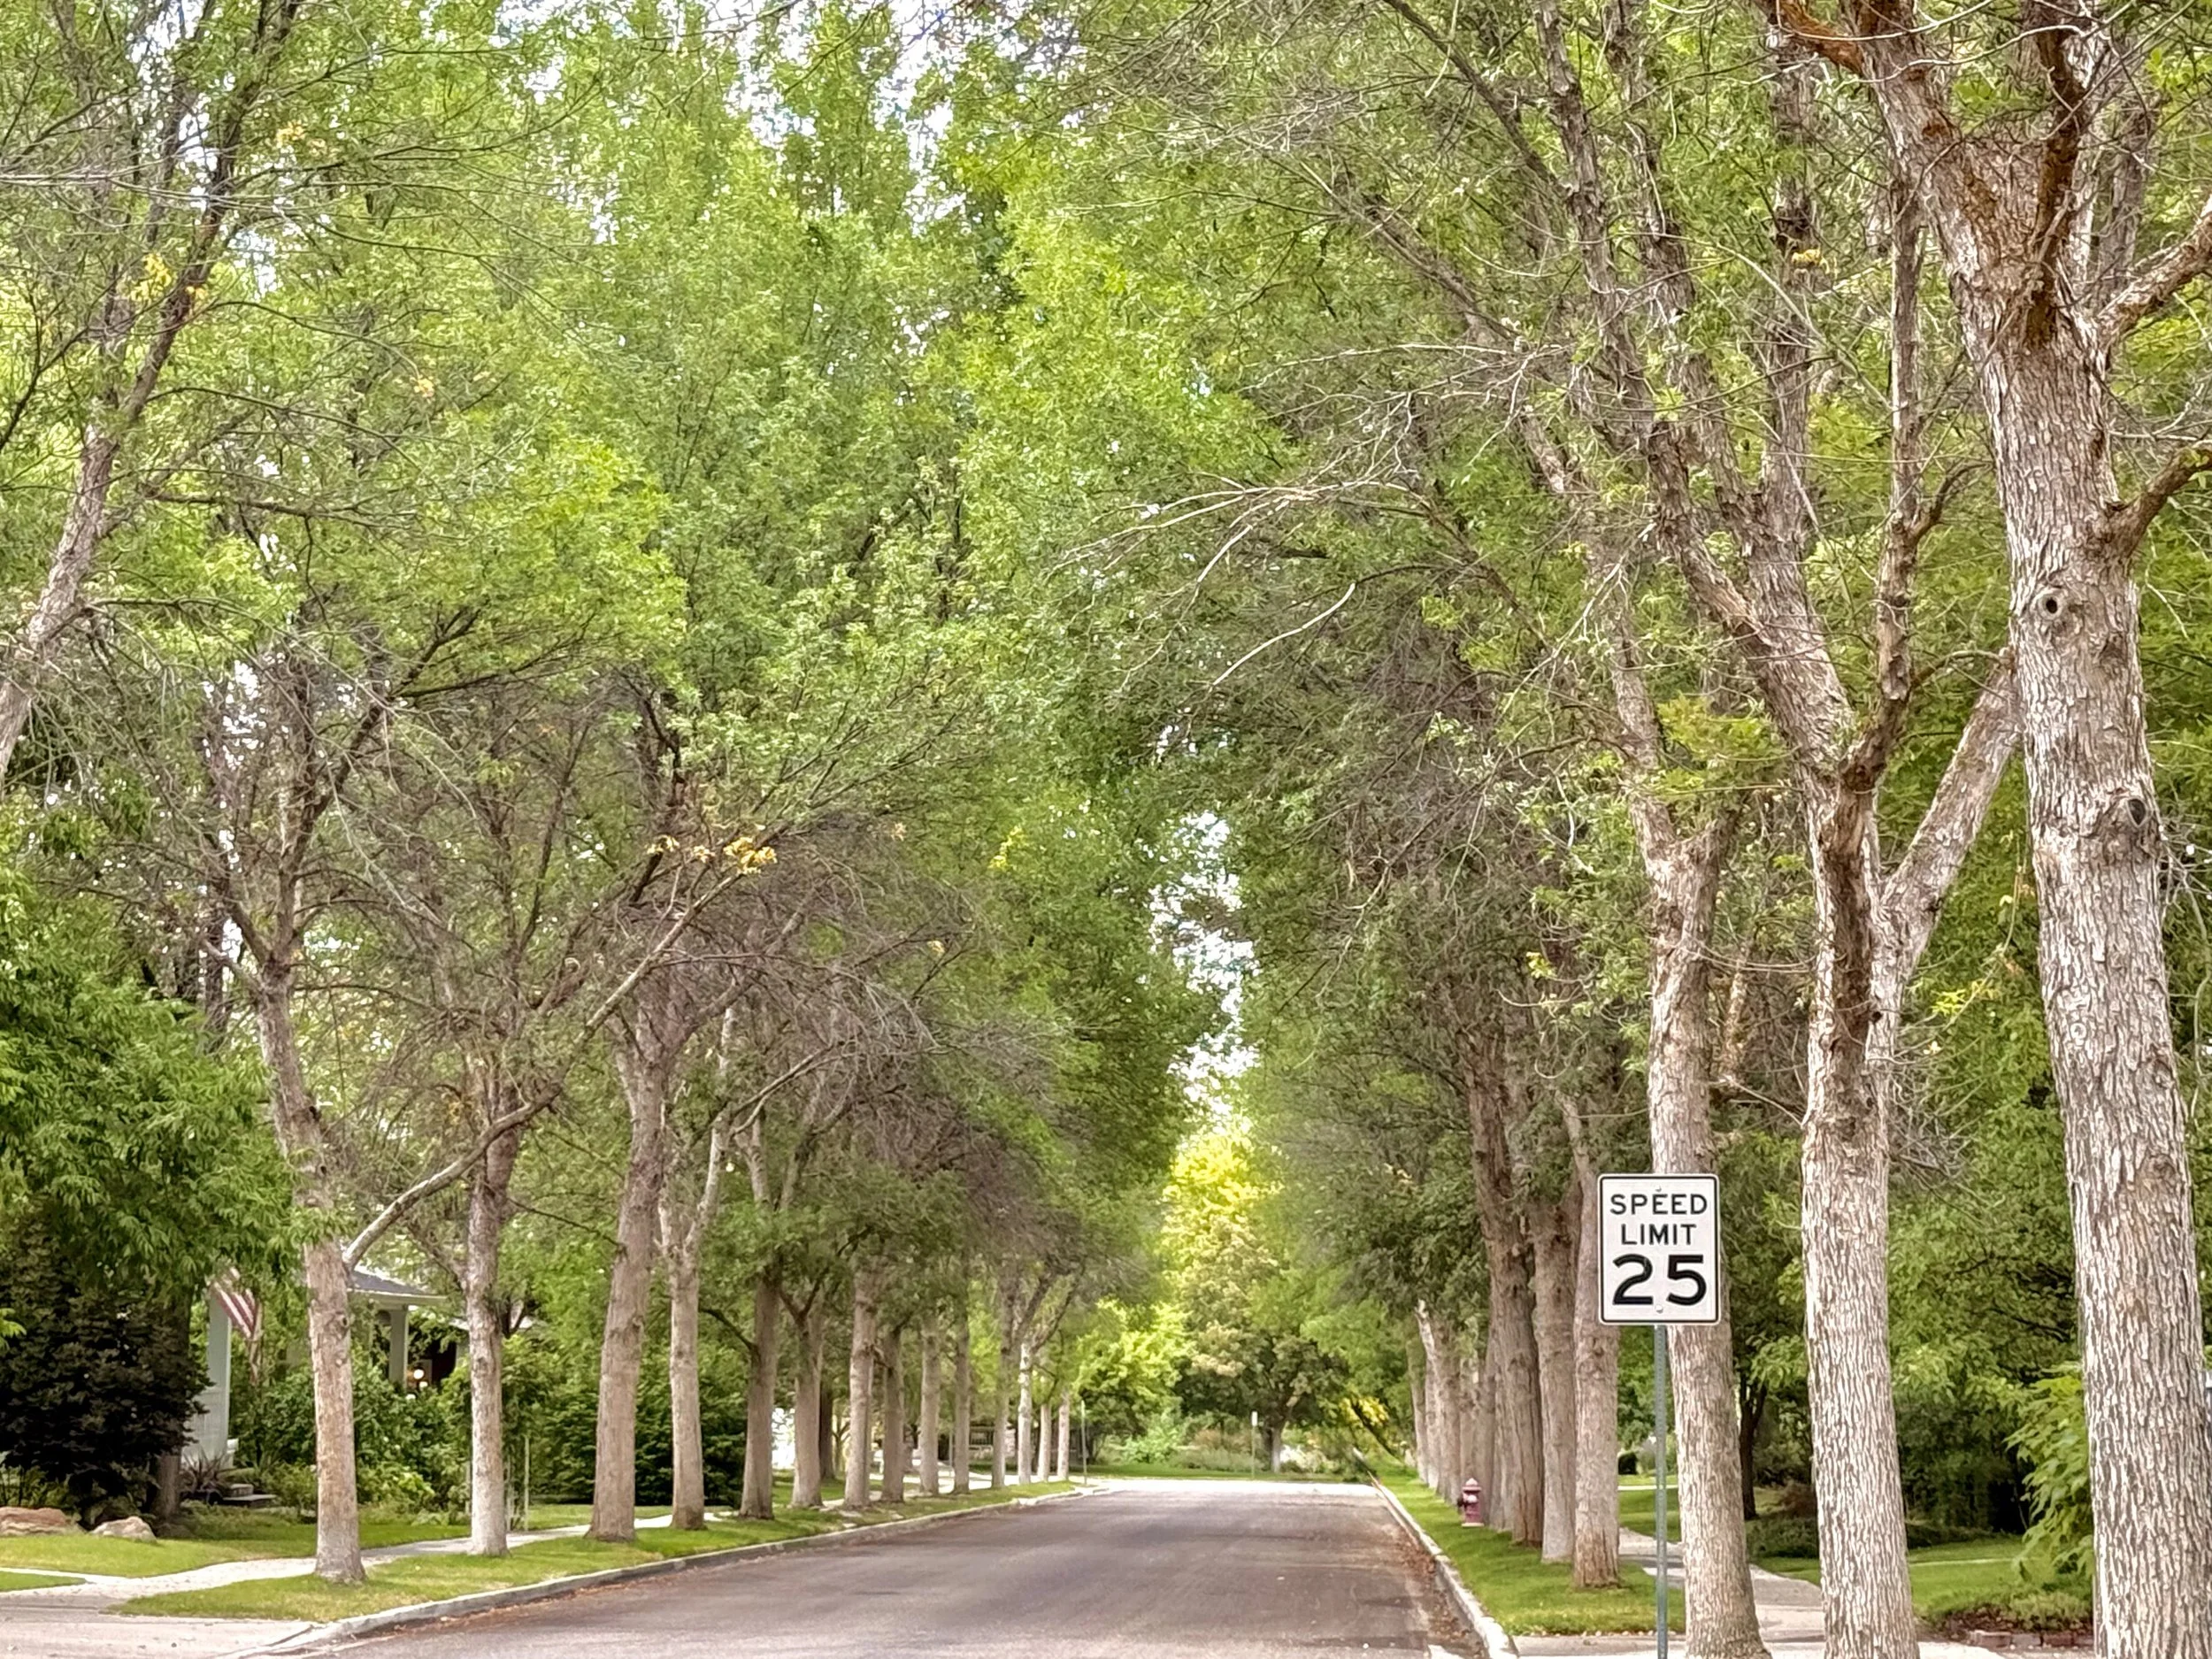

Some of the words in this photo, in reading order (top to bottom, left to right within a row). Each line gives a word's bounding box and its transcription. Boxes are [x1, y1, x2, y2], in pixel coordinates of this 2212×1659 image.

[1610, 1194, 1708, 1215] SPEED
[1621, 1224, 1696, 1245] LIMIT
[1612, 1254, 1707, 1306] 25
